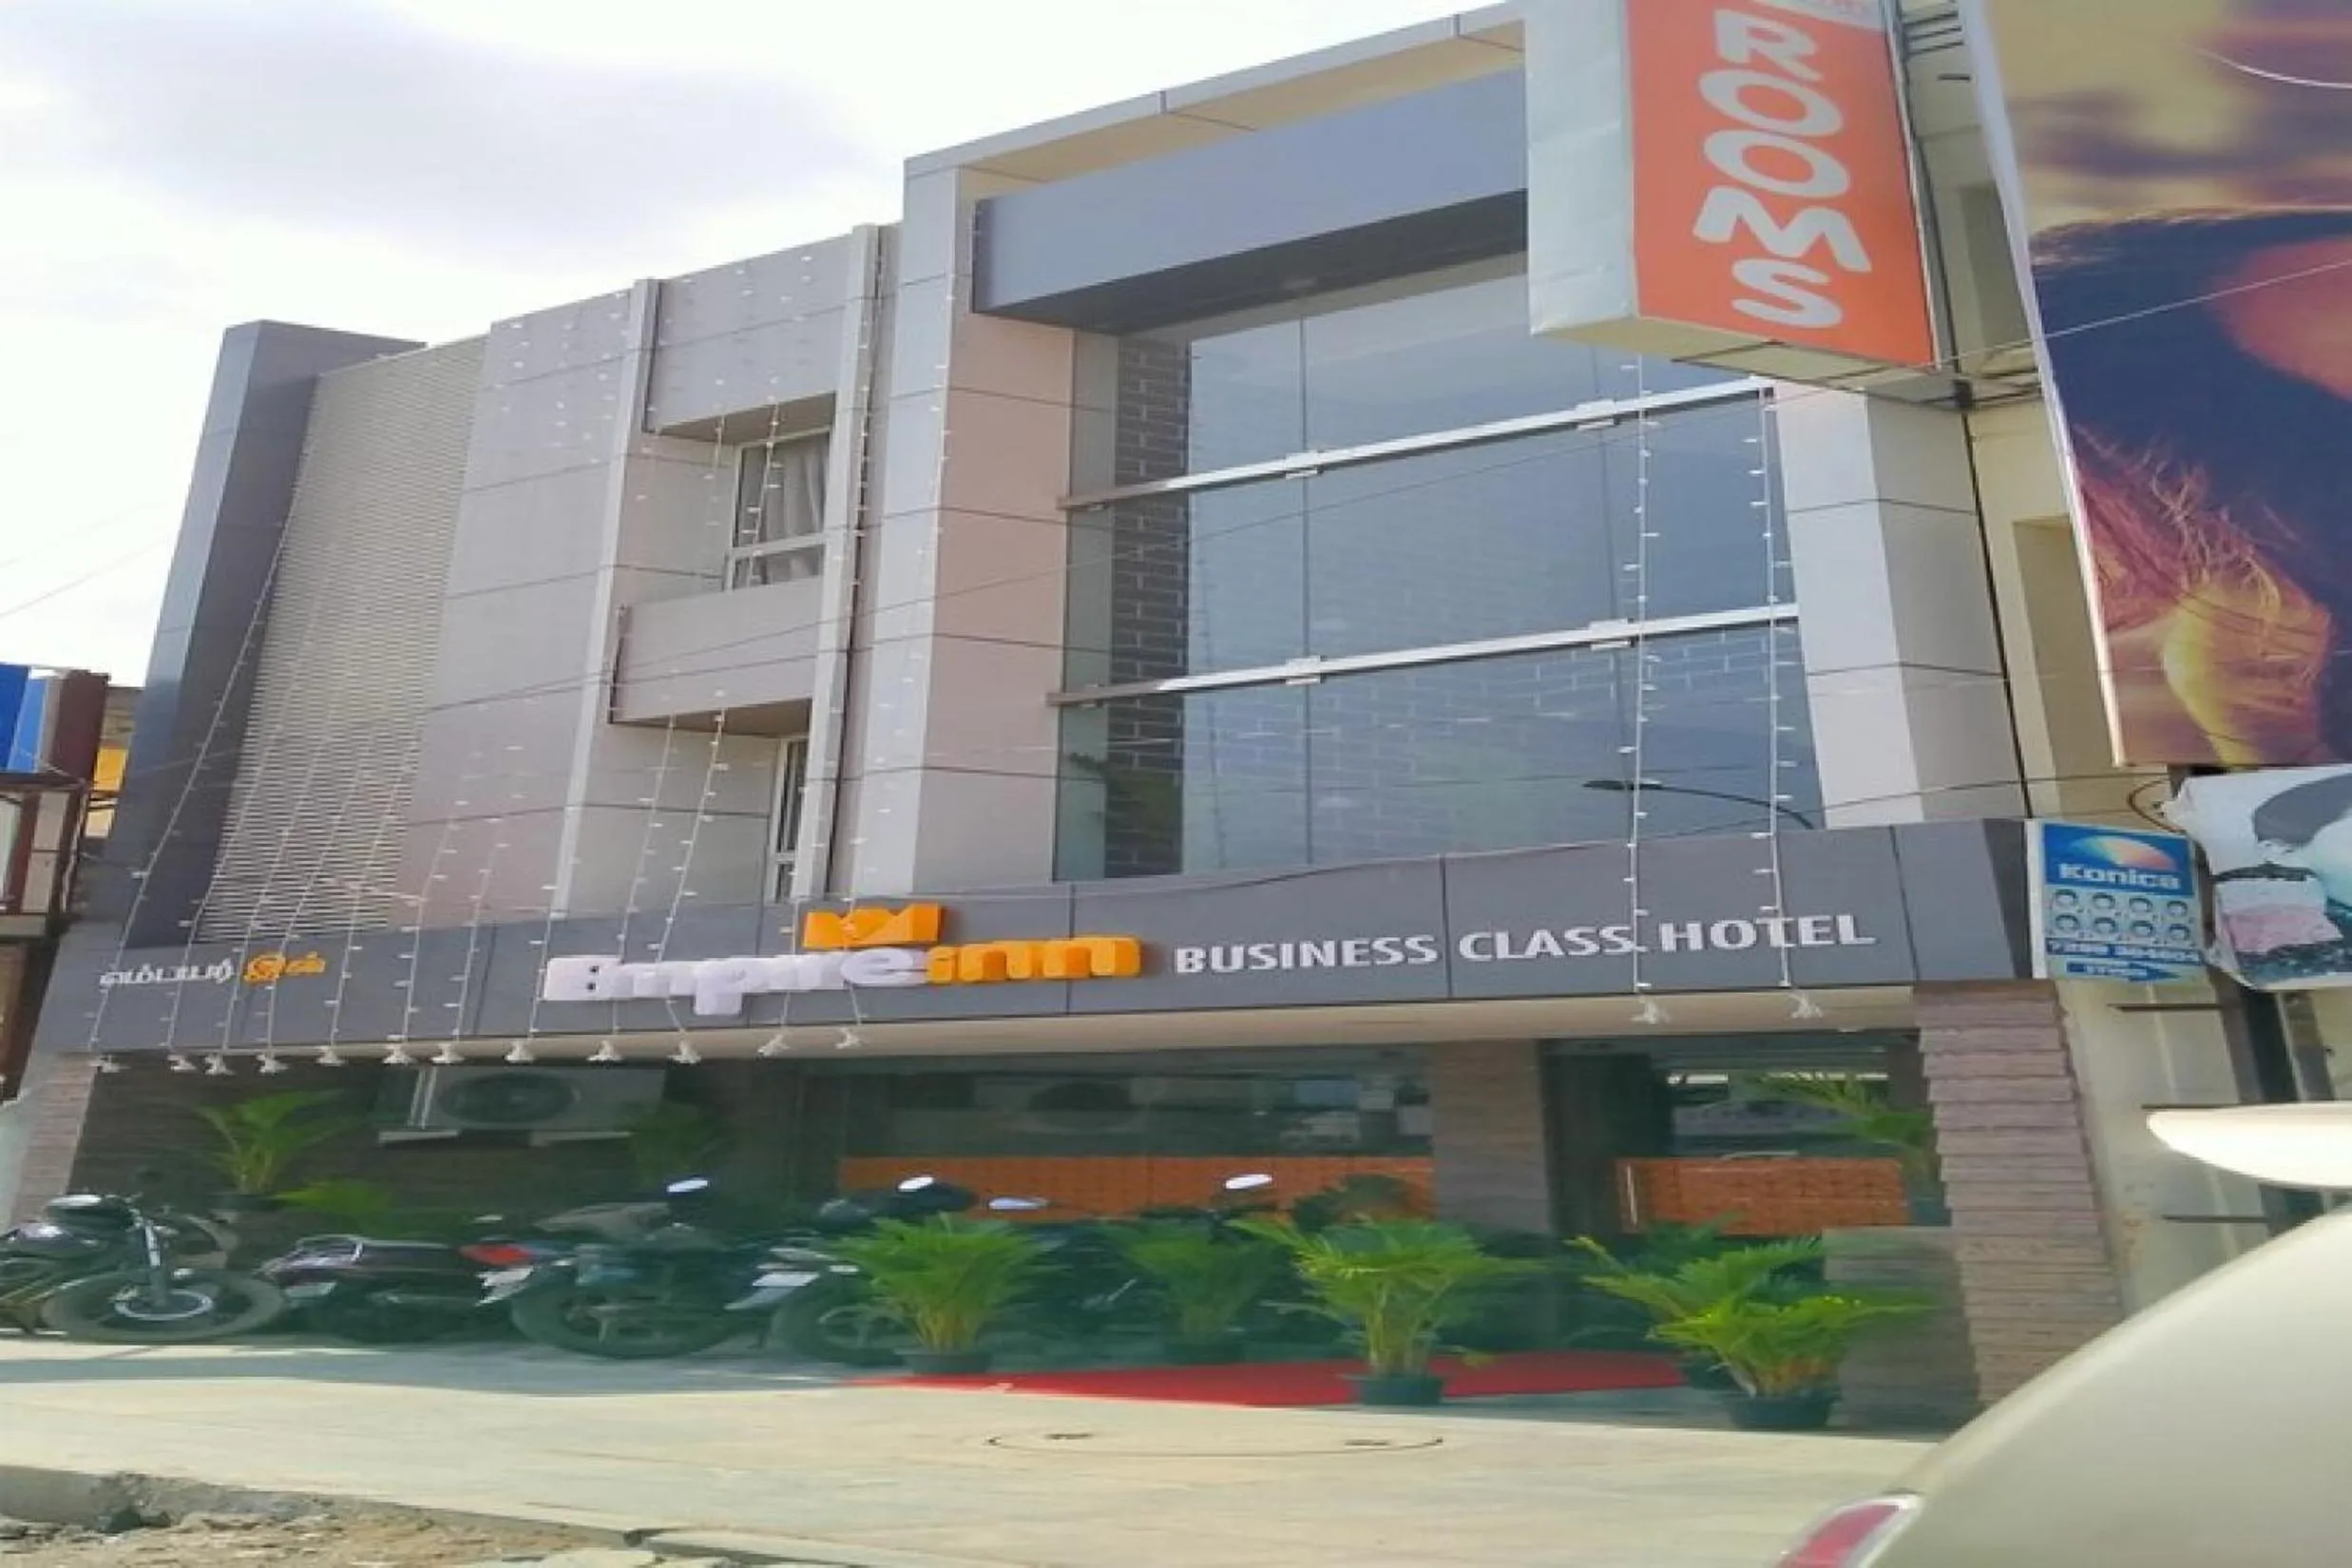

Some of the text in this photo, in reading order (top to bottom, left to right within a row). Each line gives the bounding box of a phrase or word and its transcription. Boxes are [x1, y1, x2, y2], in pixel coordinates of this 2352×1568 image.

[1692, 9, 1871, 329] ROOMS
[2058, 863, 2181, 889] Konica
[927, 936, 1141, 985] inn
[1176, 913, 1877, 974] BUSINESS CLASS HOTEL
